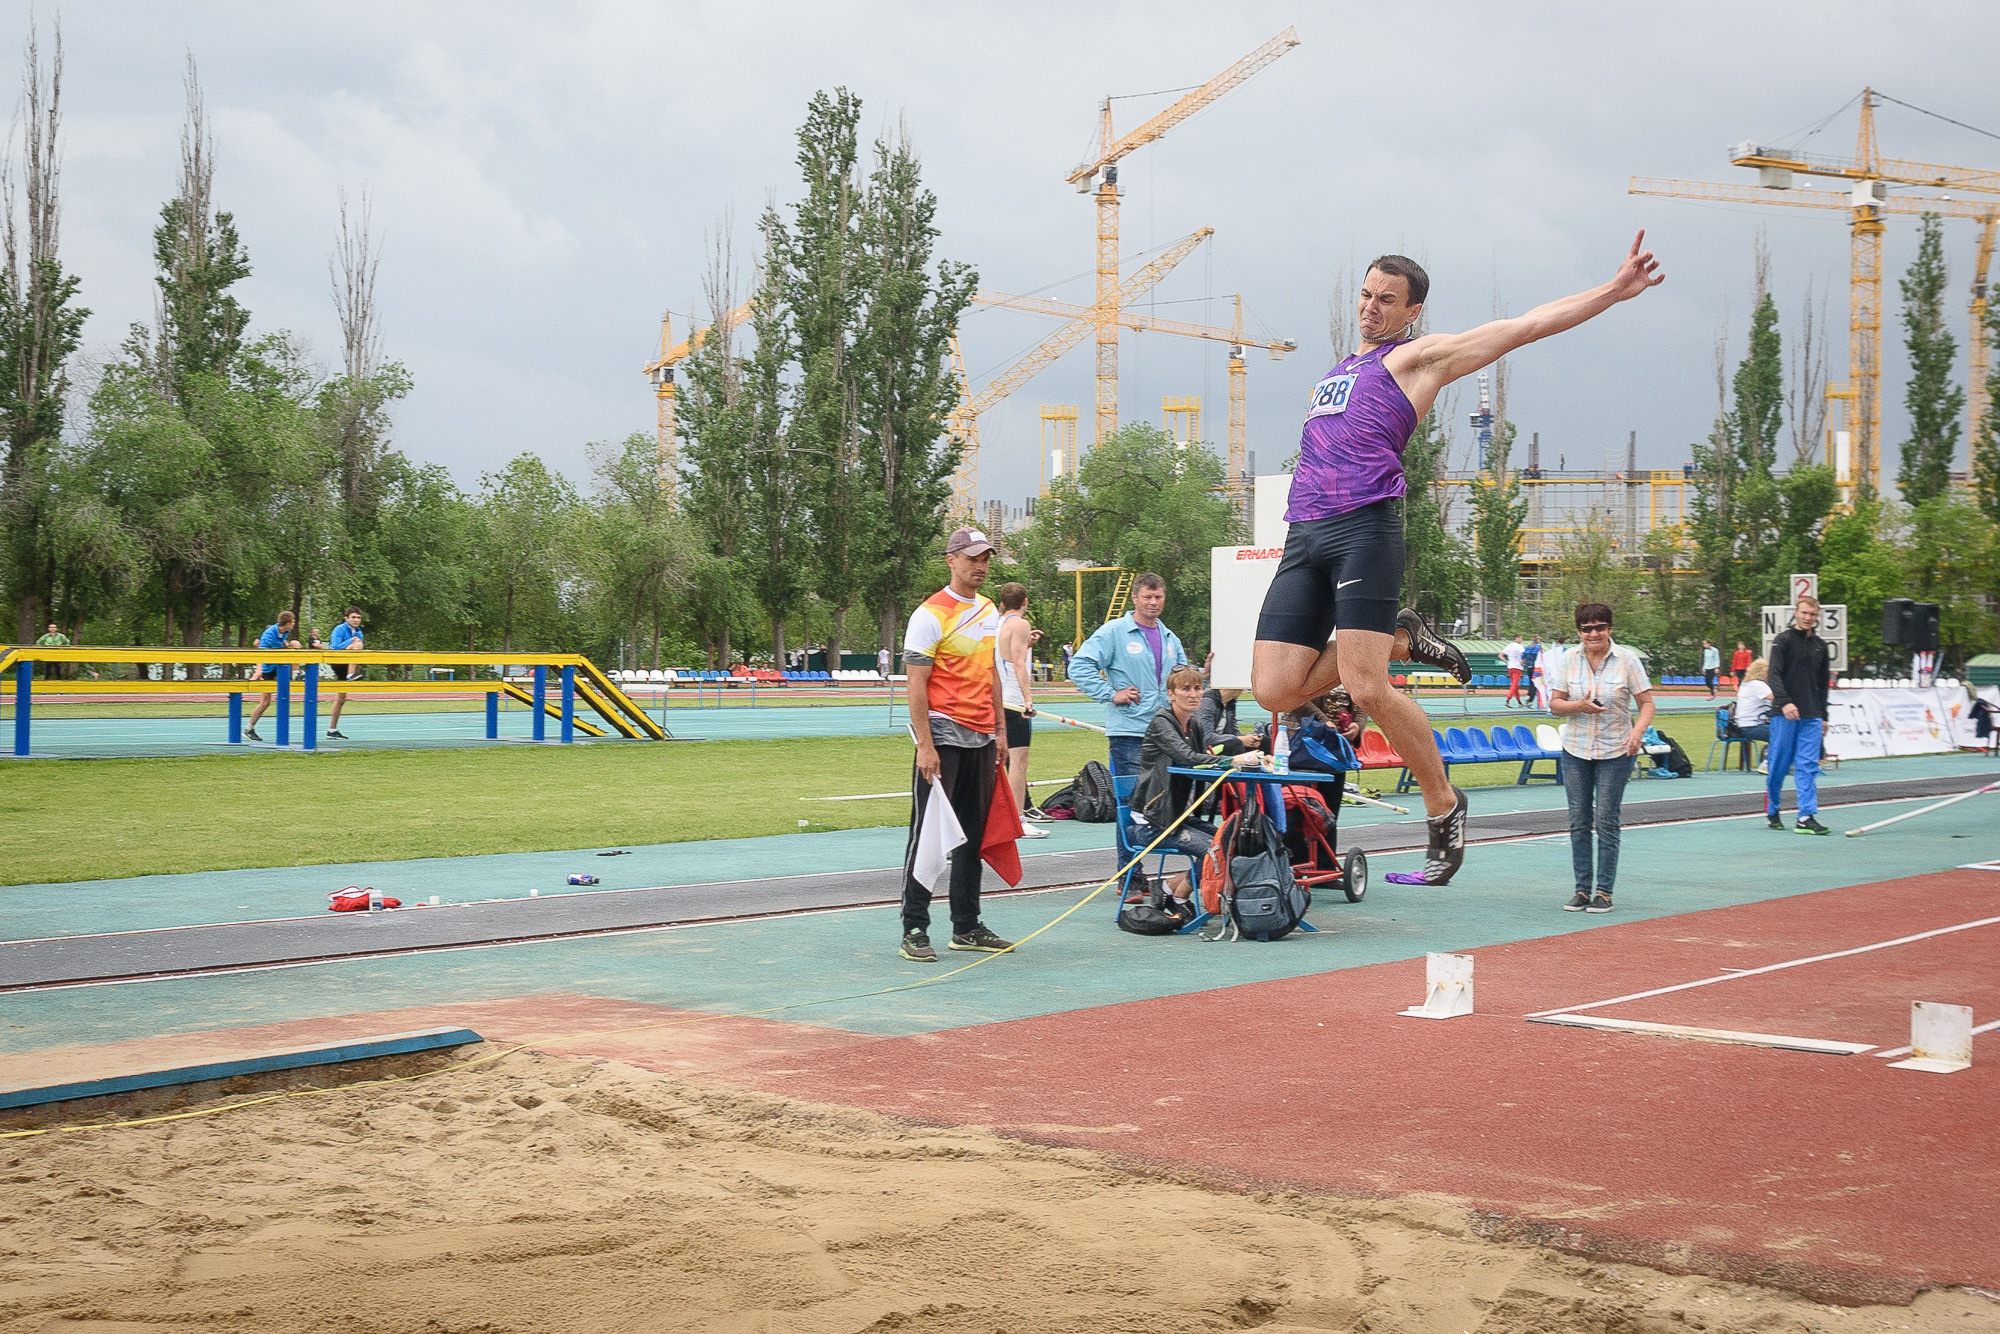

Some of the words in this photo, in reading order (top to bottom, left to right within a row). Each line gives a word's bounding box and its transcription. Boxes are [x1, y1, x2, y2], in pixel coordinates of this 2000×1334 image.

[1311, 380, 1349, 410] 288
[1236, 548, 1284, 560] ERHARD
[1795, 578, 1810, 599] 2
